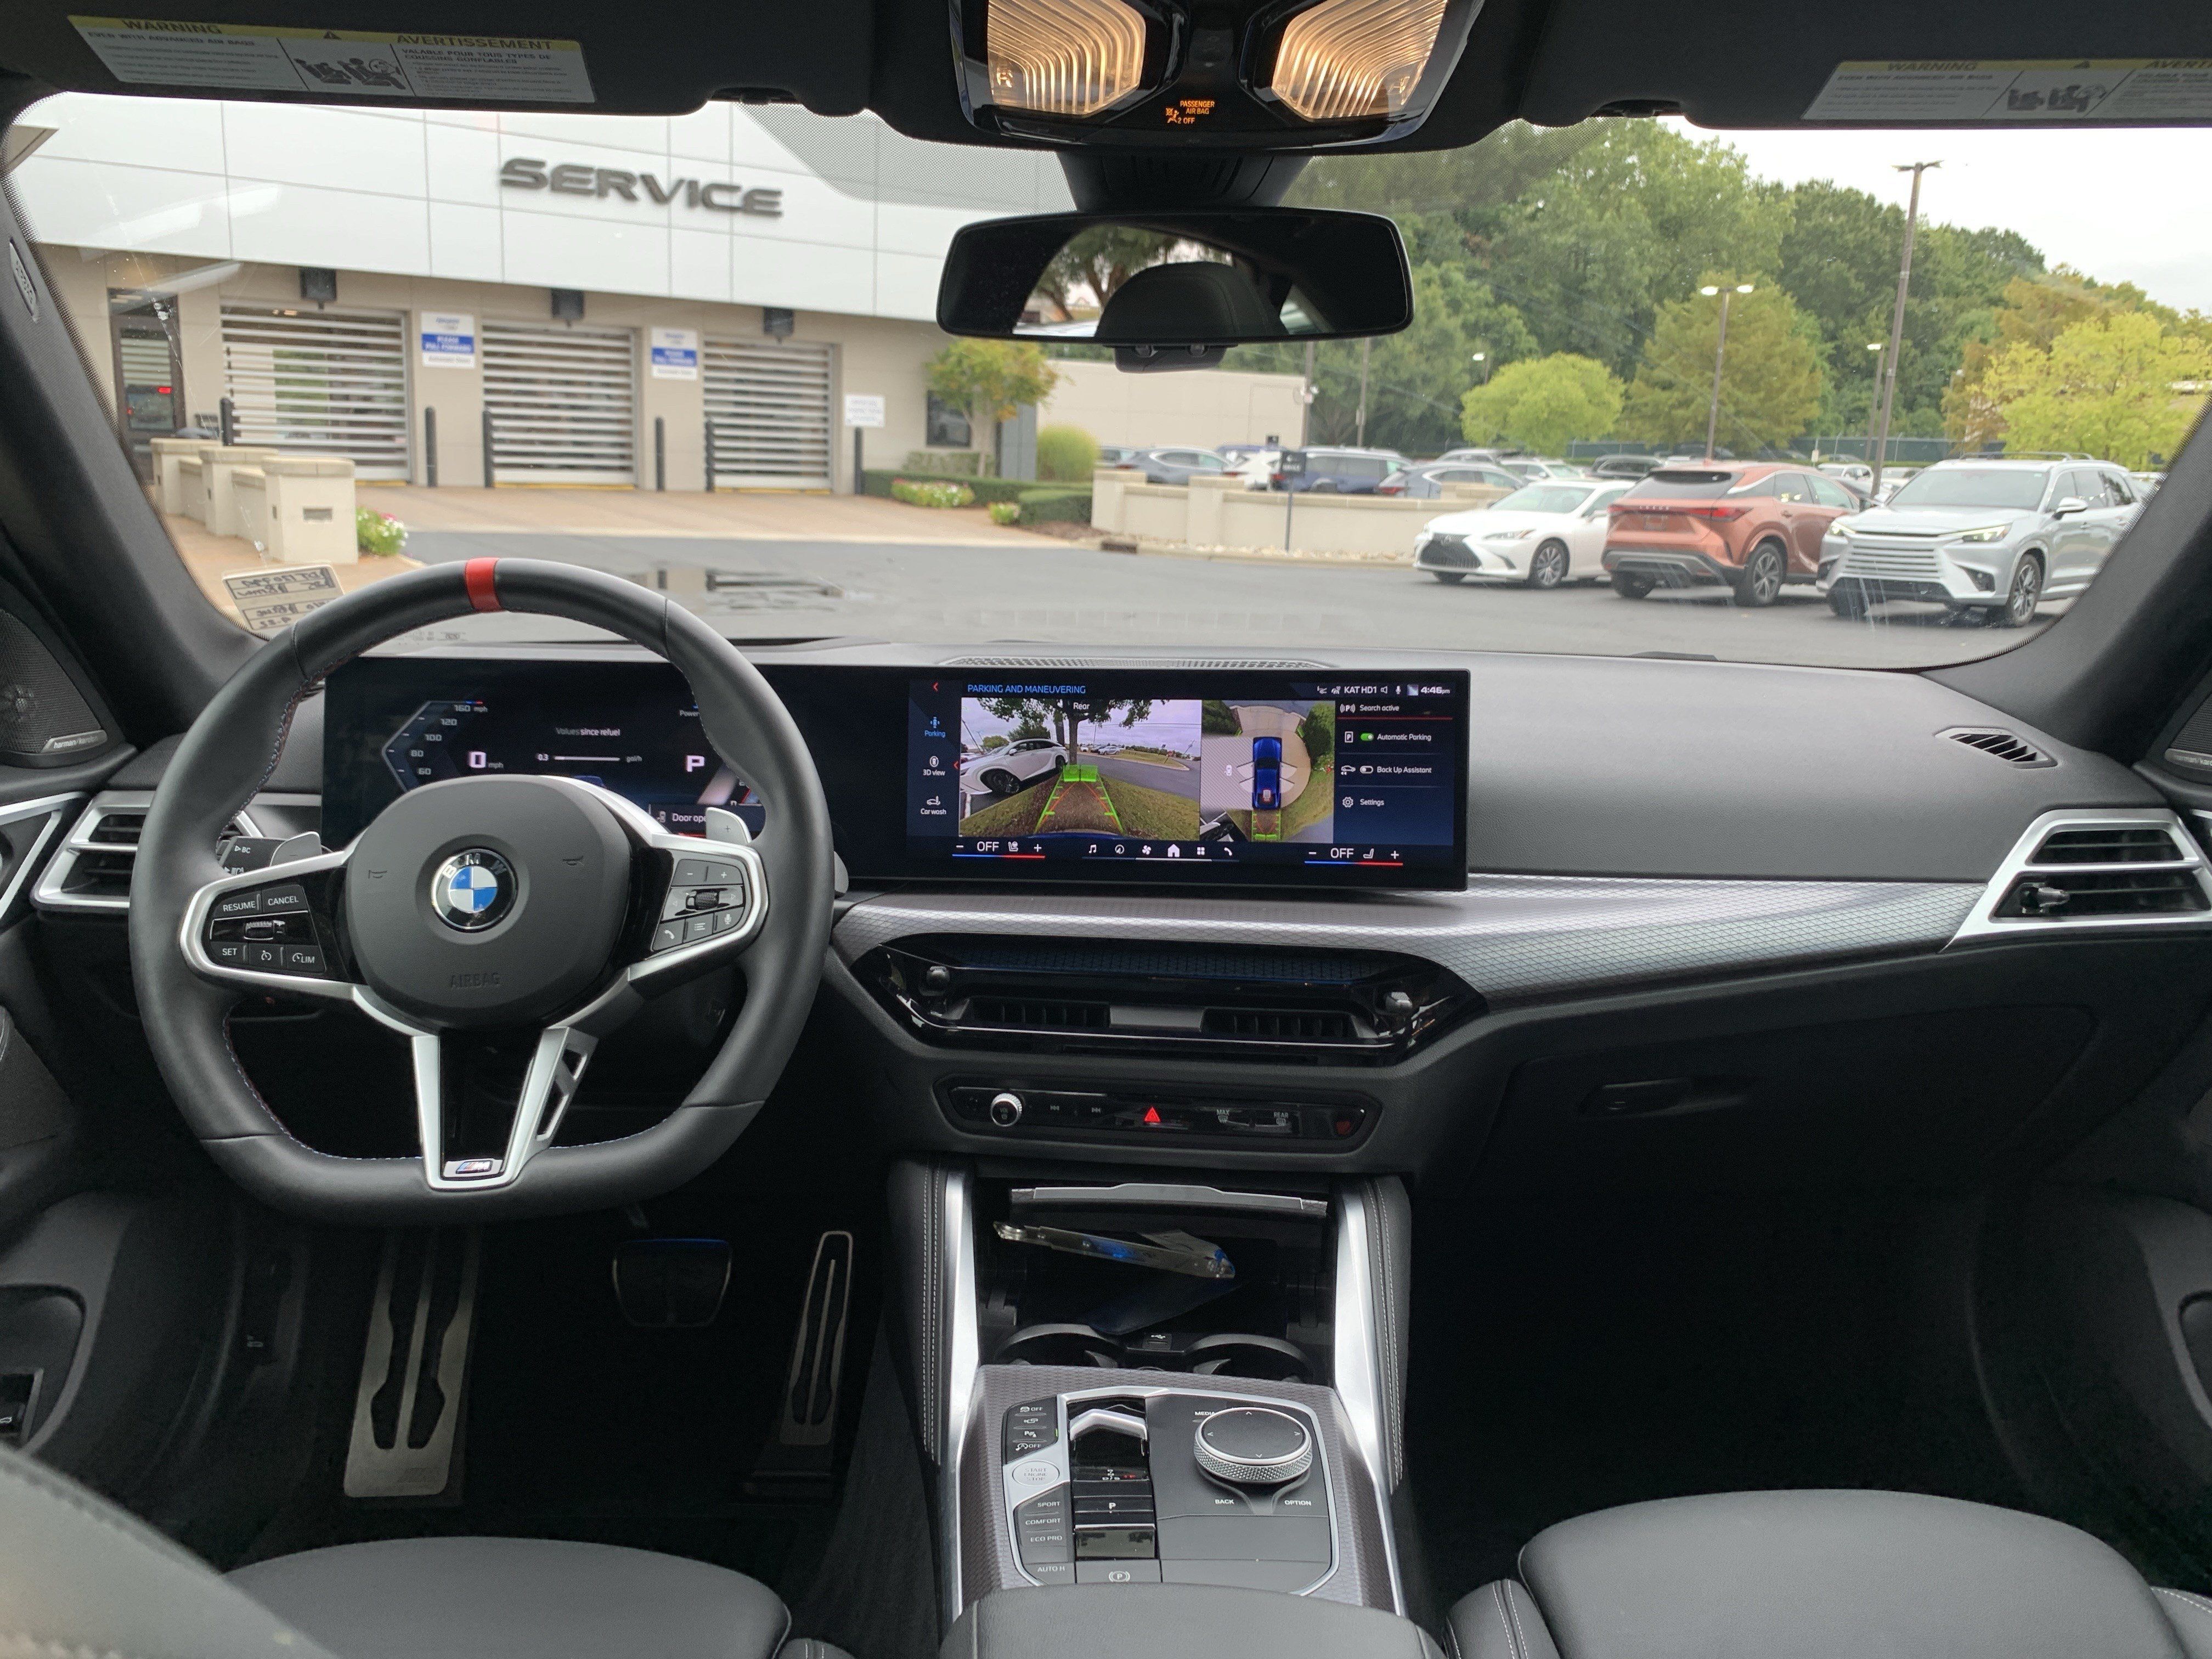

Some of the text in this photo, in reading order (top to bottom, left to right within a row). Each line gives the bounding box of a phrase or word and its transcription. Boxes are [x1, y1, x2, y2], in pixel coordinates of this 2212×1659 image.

[122, 20, 223, 34] WARNING
[397, 35, 553, 49] AVERTISSEMENT
[1887, 61, 1977, 71] WARNING
[499, 157, 783, 219] SERVICE
[967, 684, 1086, 694] PARKING AND MANEUVERING
[1344, 686, 1360, 694] KAT
[441, 718, 458, 726] 120
[556, 727, 580, 736] Values
[600, 728, 621, 736] refuel
[924, 730, 946, 738] Parking
[425, 734, 442, 742] 100
[1409, 733, 1432, 742] Parking
[537, 753, 549, 761] 0.3
[488, 761, 504, 770] mph
[686, 754, 705, 772] P
[1359, 799, 1385, 807] Settings
[672, 812, 692, 822] Door
[977, 840, 999, 853] OFF
[1330, 847, 1355, 859] OFF
[442, 853, 507, 879] BMW
[268, 895, 300, 906] CANCEL
[223, 900, 256, 912] RESUME
[222, 947, 238, 956] SET
[301, 956, 315, 964] LIM
[450, 973, 500, 988] AIRBAG
